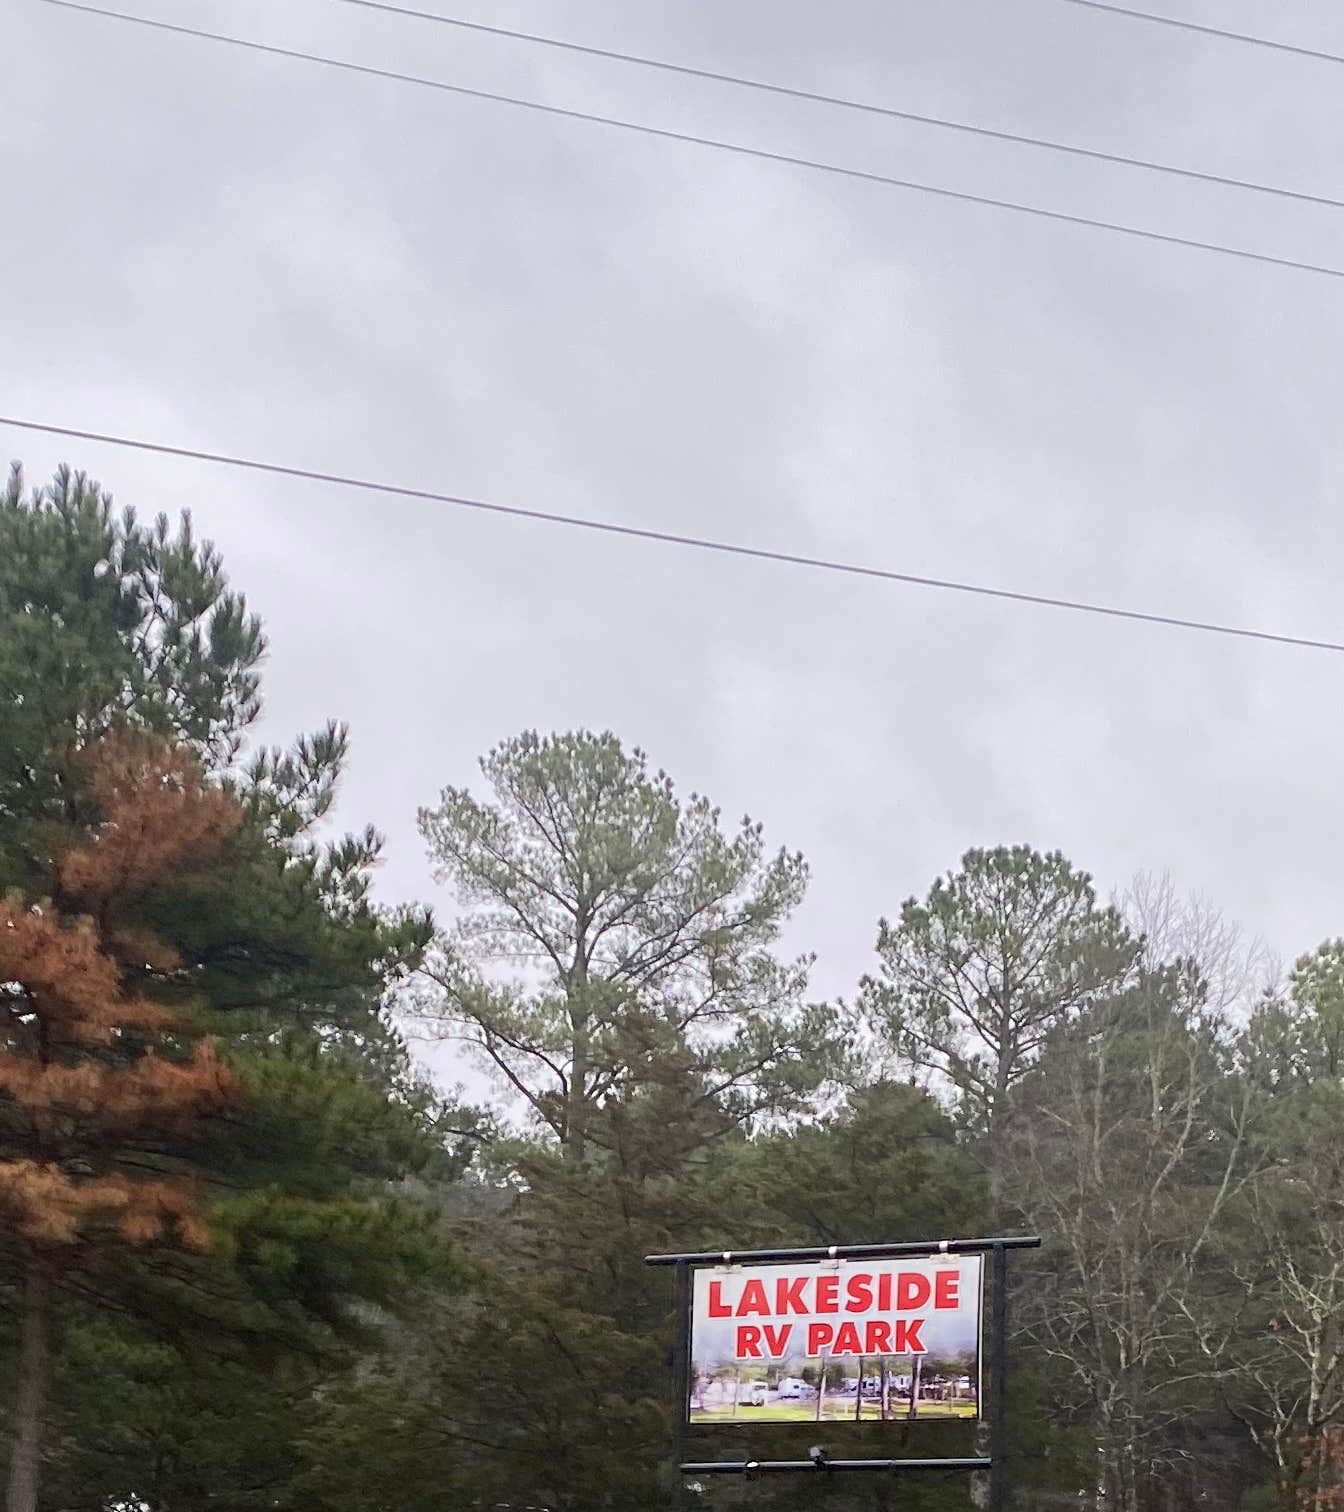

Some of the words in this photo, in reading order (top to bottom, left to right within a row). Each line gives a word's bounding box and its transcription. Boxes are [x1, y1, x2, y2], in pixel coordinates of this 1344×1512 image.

[708, 1270, 960, 1318] LAKESIDE
[735, 1323, 793, 1358] RV
[807, 1319, 927, 1357] PARK
